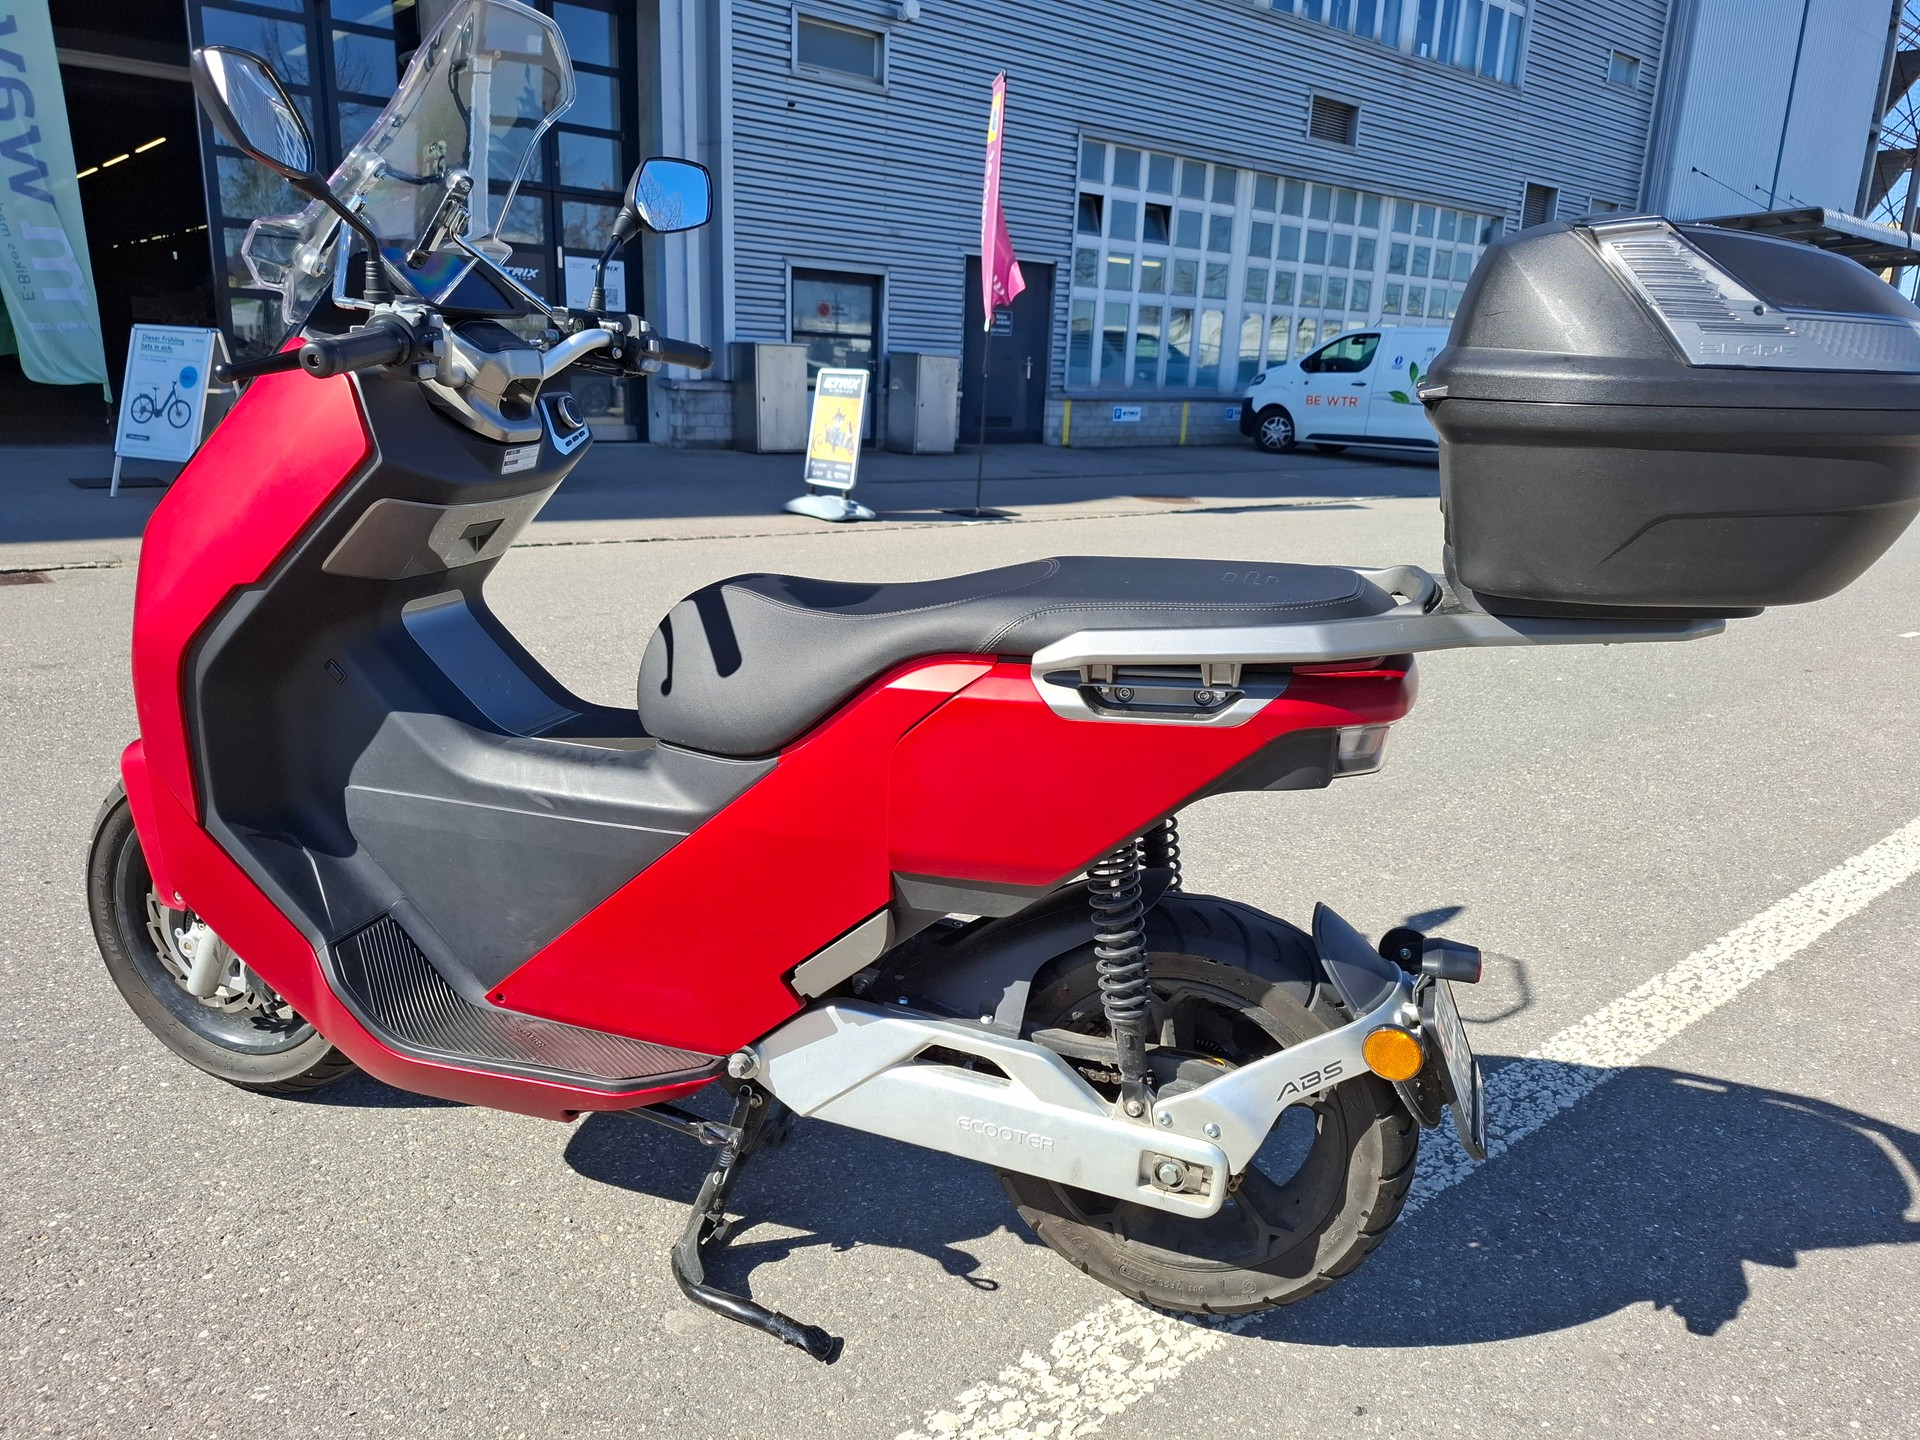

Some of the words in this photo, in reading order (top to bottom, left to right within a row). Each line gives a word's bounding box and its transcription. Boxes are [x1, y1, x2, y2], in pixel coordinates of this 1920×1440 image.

[503, 266, 540, 278] TRIX
[1305, 395, 1321, 406] BE
[1327, 395, 1358, 407] WTR
[1276, 1059, 1344, 1102] ABS
[957, 1115, 1056, 1153] ECOOTER
